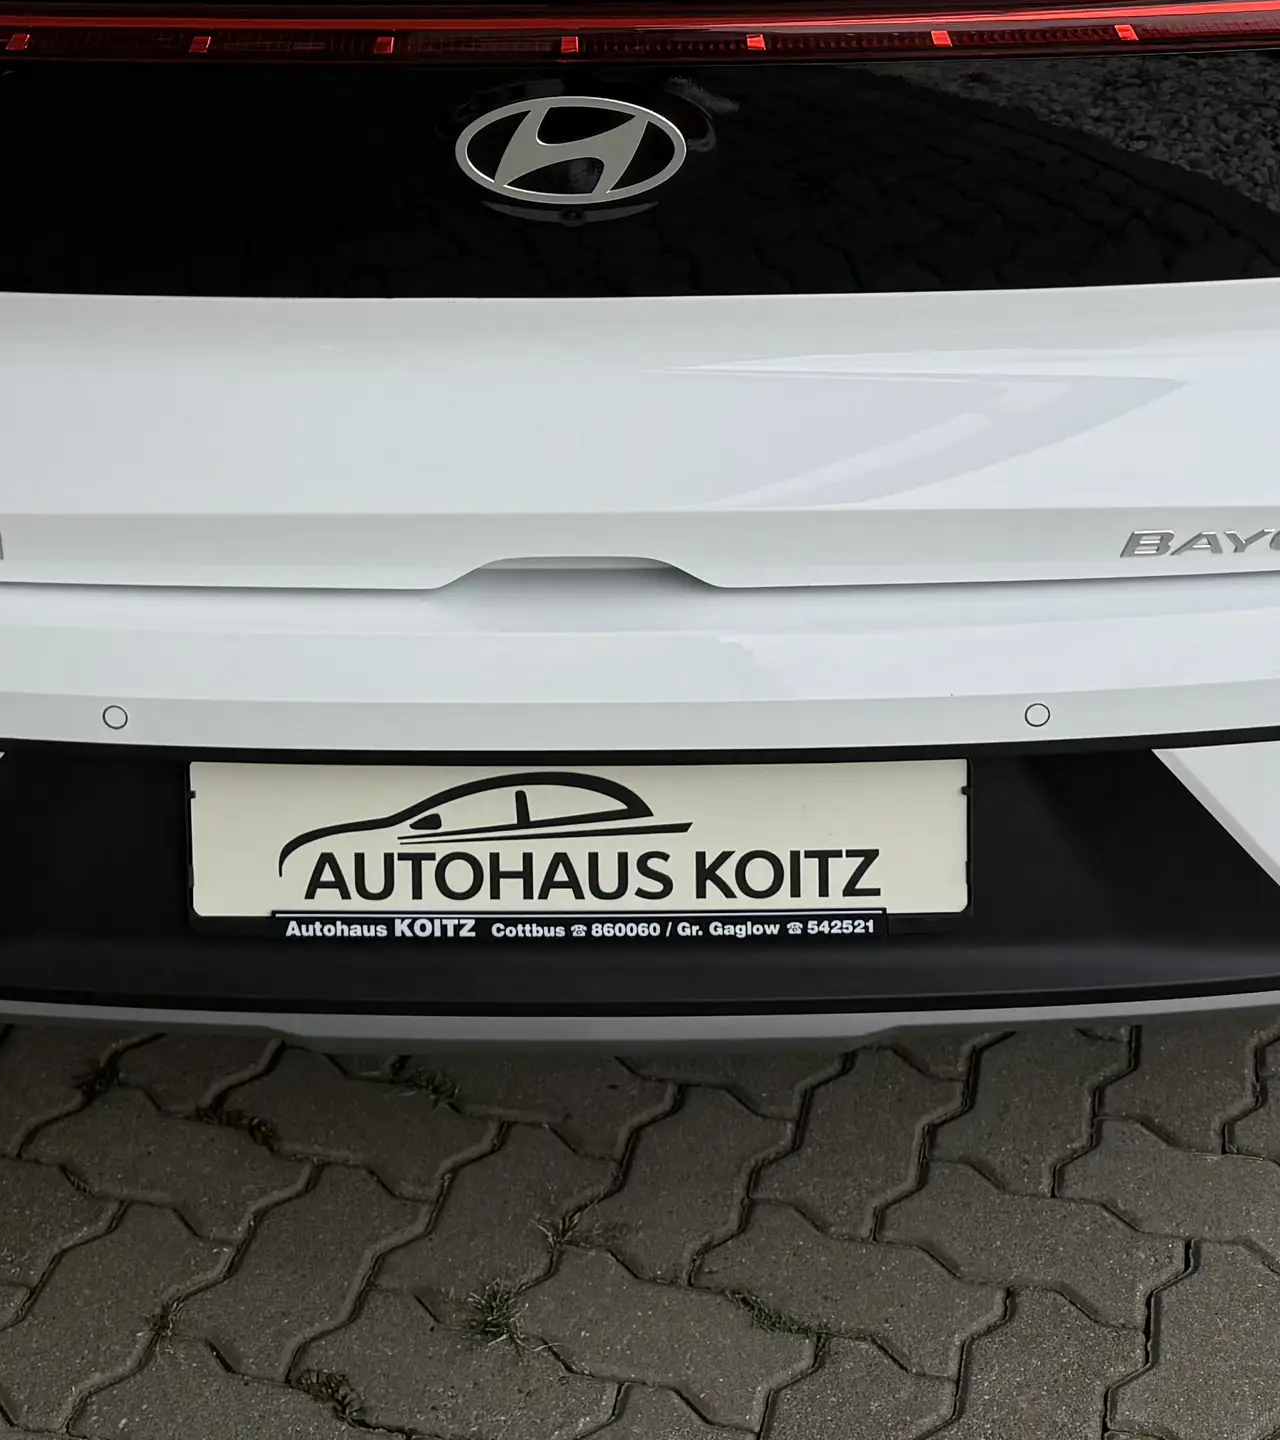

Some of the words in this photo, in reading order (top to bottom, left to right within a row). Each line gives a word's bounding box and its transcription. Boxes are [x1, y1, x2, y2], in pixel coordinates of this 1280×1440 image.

[303, 848, 675, 902] AUTOHAUS
[694, 847, 883, 900] KOITZ
[285, 920, 388, 938] Autohaus
[394, 918, 477, 938] KOITZ
[491, 922, 566, 938] Cottbus
[590, 921, 661, 937] 860060
[676, 921, 703, 937] Gr.
[708, 920, 781, 939] Gaglow
[806, 918, 876, 935] 542521
